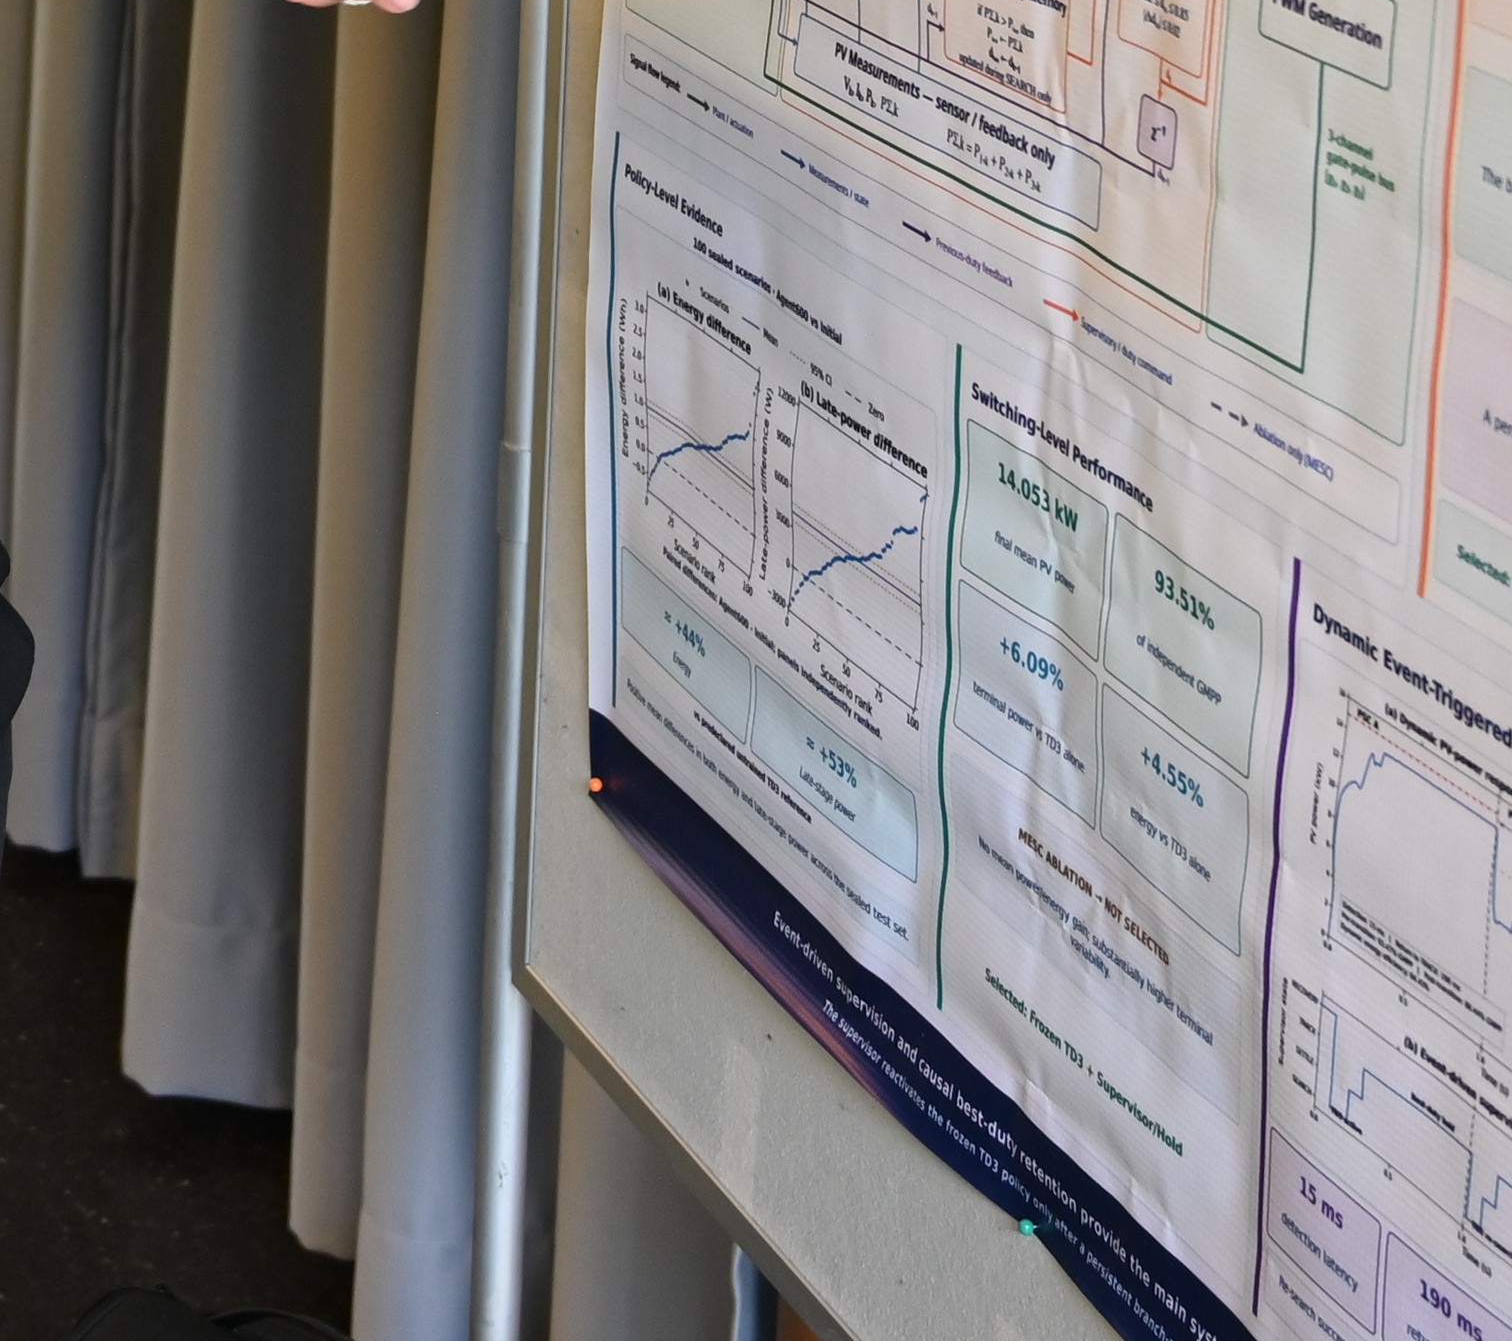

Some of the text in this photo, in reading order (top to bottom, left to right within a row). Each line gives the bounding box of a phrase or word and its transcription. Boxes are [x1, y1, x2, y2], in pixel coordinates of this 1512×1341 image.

[1307, 1, 1383, 50] Generation
[833, 40, 849, 62] PV
[847, 49, 921, 100] Measurements
[934, 95, 971, 124] sensor
[978, 113, 1029, 155] feedback
[1029, 143, 1056, 172] only
[623, 162, 724, 238] Policy-Level Evidence
[971, 382, 1154, 513] Switching-Level Performance
[997, 461, 1079, 533] 14.053 kW
[1154, 569, 1216, 631] 93.51%
[1312, 602, 1379, 662] Dynamic
[999, 637, 1065, 692] +6.09%
[819, 746, 858, 789] +53%
[1141, 747, 1205, 808] +4.55%
[984, 967, 1028, 1018] Selected:
[1028, 1008, 1063, 1051] Frozen
[1063, 1039, 1085, 1070] TD3
[1096, 1071, 1184, 1157] Supervisor/Hold
[772, 910, 1188, 1324] Event-driven supervision and causal best-duty retention provide the main
[1299, 1175, 1344, 1230] 15 ms
[1419, 1278, 1483, 1341] 190 ms
